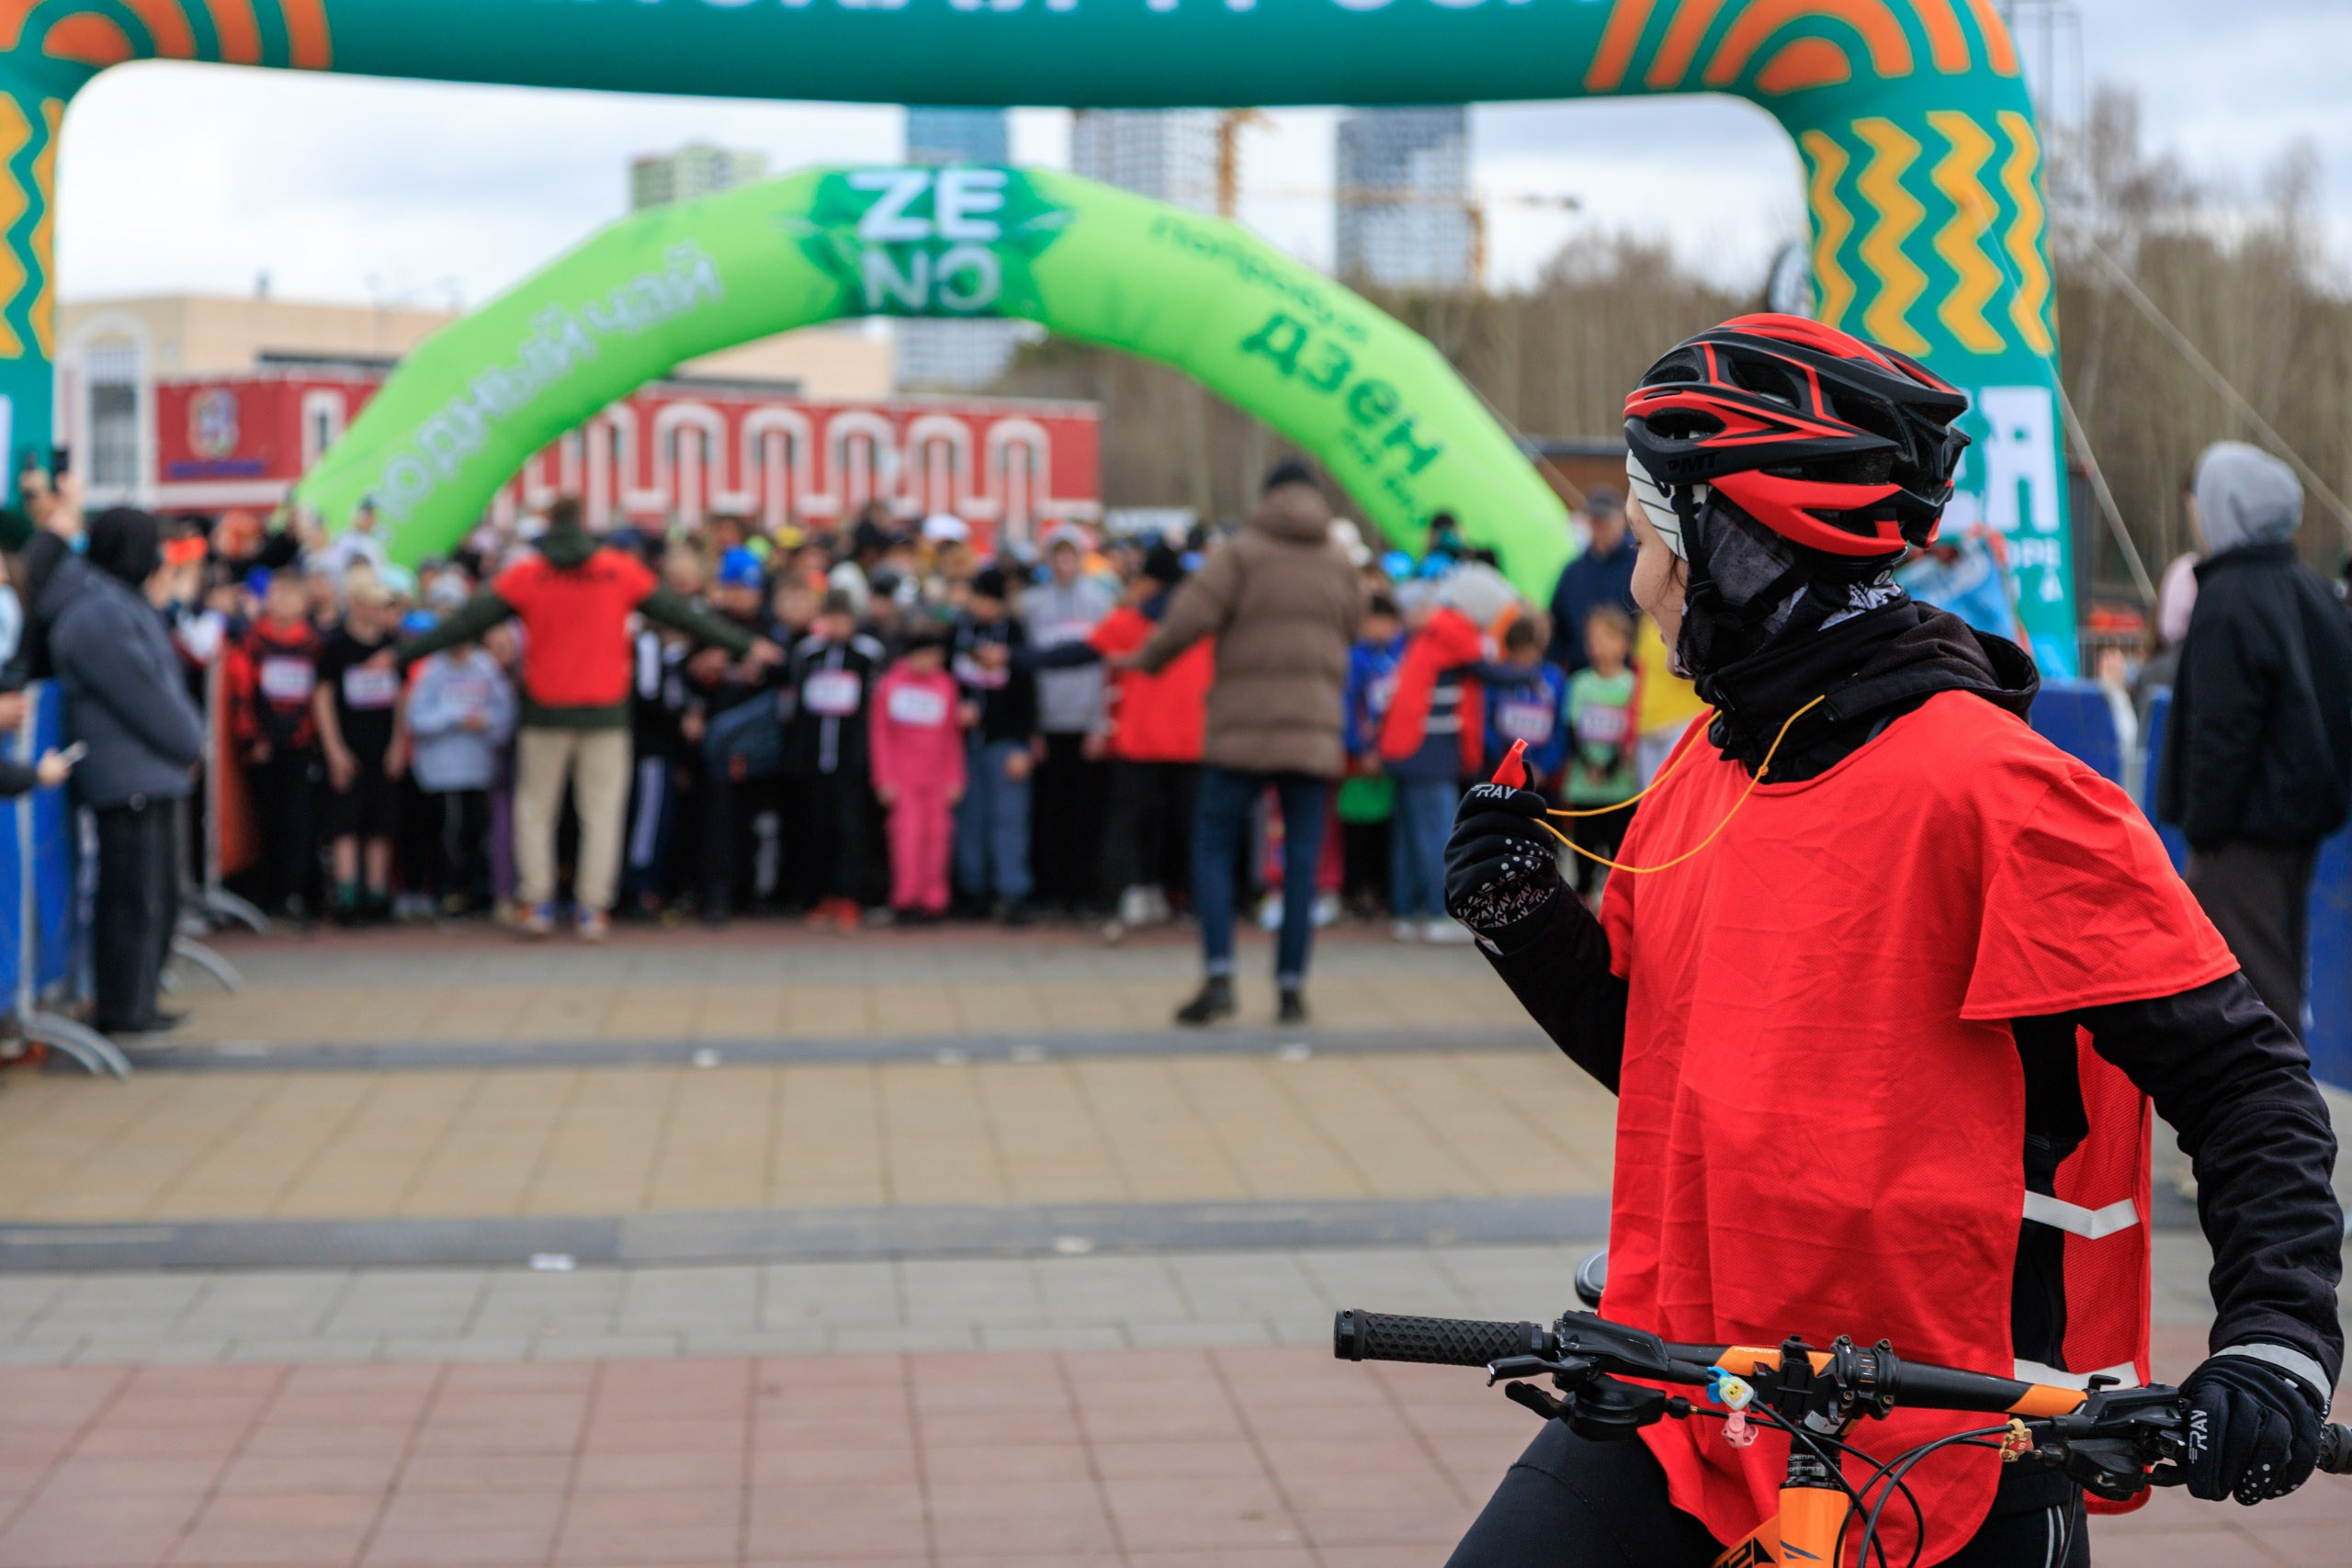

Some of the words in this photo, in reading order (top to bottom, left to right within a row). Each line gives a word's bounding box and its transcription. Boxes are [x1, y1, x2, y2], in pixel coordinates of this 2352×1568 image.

[1472, 784, 1519, 800] RAY
[1735, 1347, 1781, 1355] FORMA
[2189, 1410, 2208, 1461] RAY
